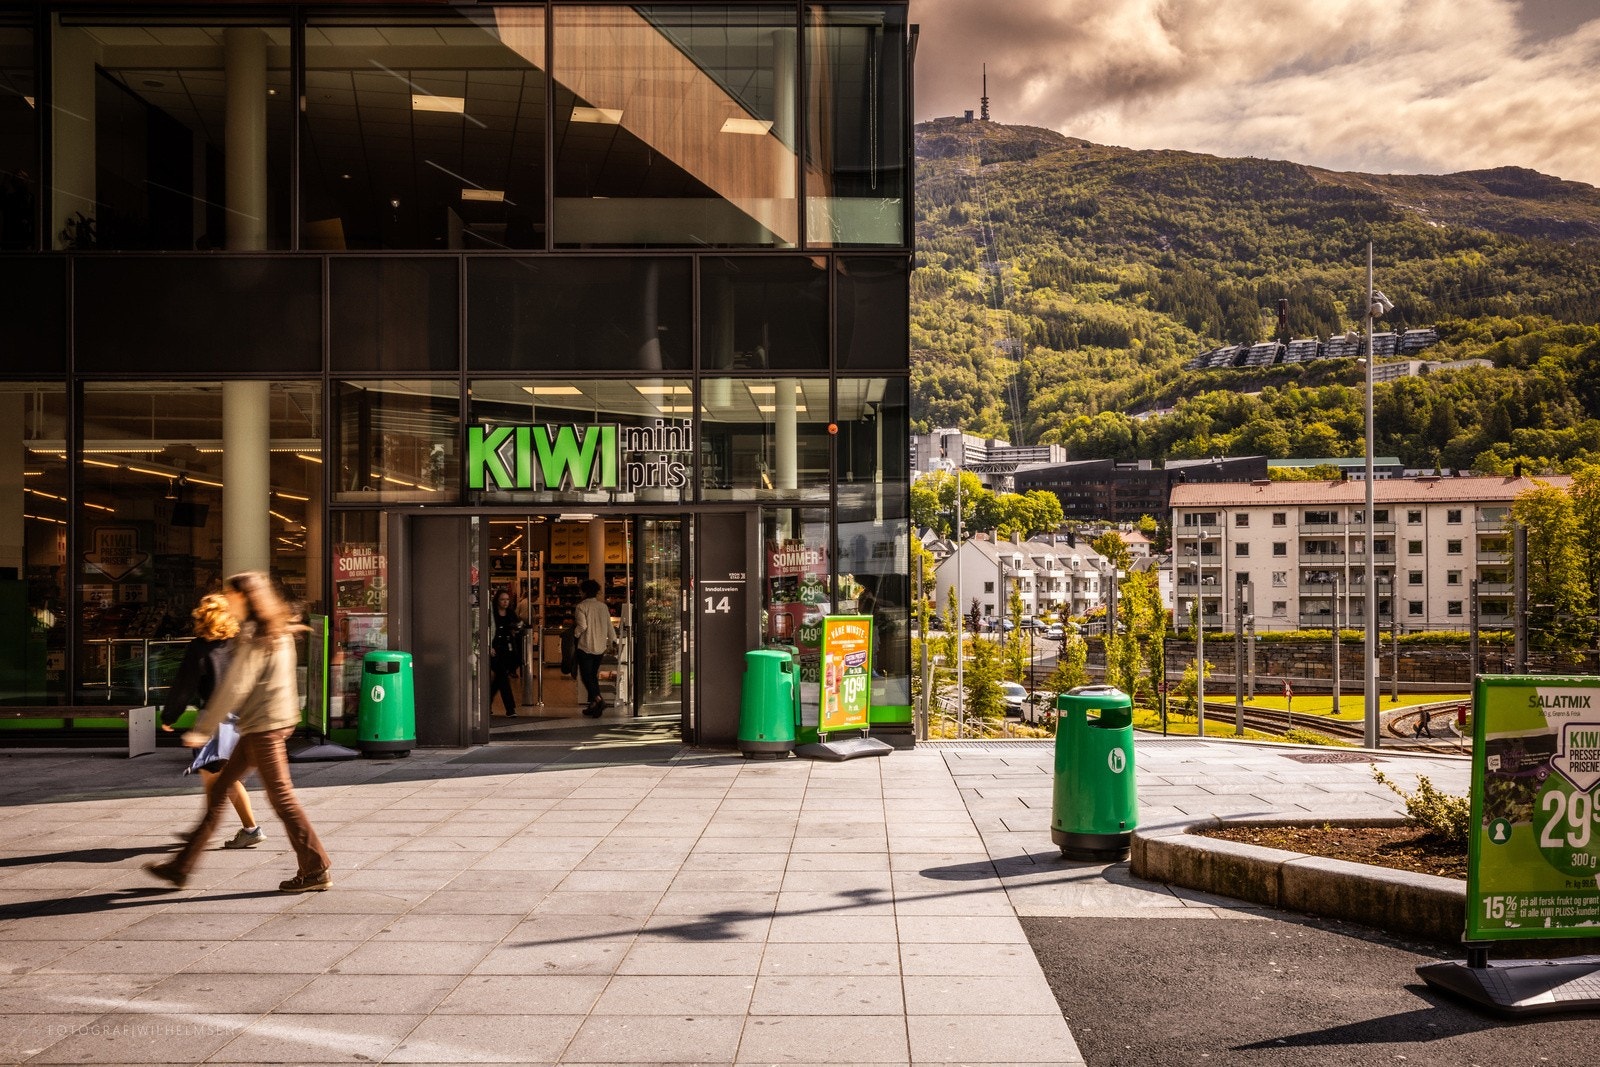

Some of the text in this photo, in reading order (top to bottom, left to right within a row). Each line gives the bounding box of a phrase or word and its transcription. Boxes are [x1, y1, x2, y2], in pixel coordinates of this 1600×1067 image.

[626, 419, 693, 452] mini
[467, 425, 618, 490] KIWI
[626, 454, 687, 493] pris
[352, 548, 372, 557] BILLIG
[787, 544, 805, 553] BILLIG
[704, 596, 731, 614] 14
[1529, 695, 1591, 708] SALATMIX
[1571, 853, 1597, 868] 300 g
[1520, 896, 1599, 907] på all fersk frukt og grønt
[1527, 908, 1539, 917] alle
[1540, 907, 1555, 917] KIWI
